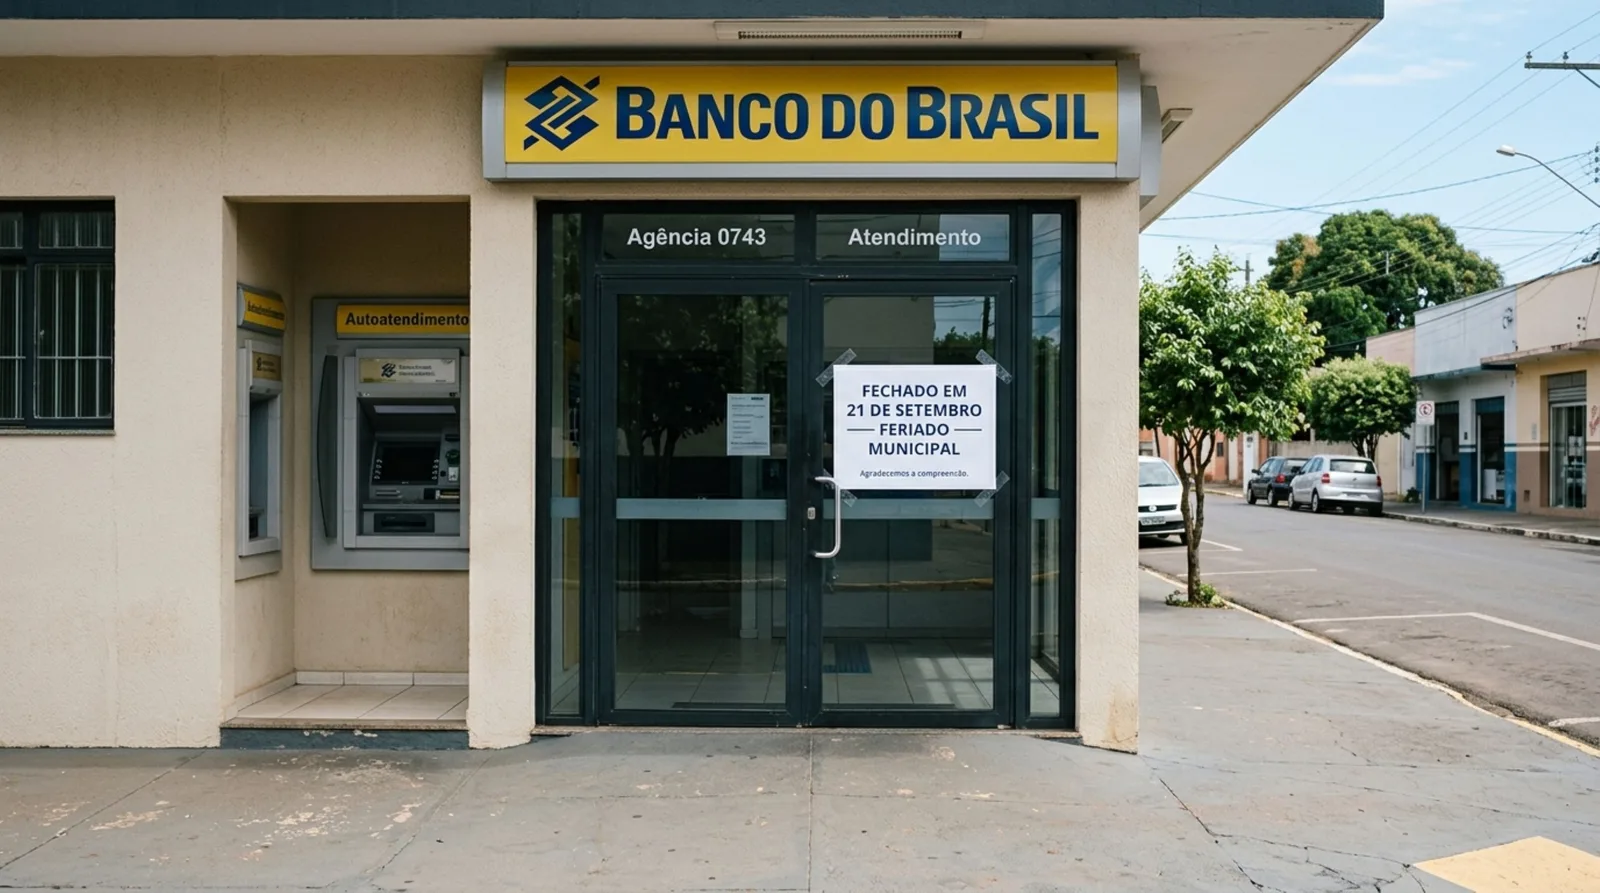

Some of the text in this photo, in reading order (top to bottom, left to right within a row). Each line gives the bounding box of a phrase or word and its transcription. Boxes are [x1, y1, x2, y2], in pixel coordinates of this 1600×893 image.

[616, 86, 1099, 141] BANCO DO BRASIL
[627, 228, 766, 249] Agência 0743
[848, 229, 982, 246] Atendimento
[345, 312, 469, 326] Autoatendimento
[863, 384, 967, 398] FECHADO EM
[847, 403, 982, 417] 21 DE SETEMBRO
[880, 423, 950, 436] FERIADO
[869, 442, 960, 455] MUNICIPAL
[860, 469, 909, 479] Agradecemos
